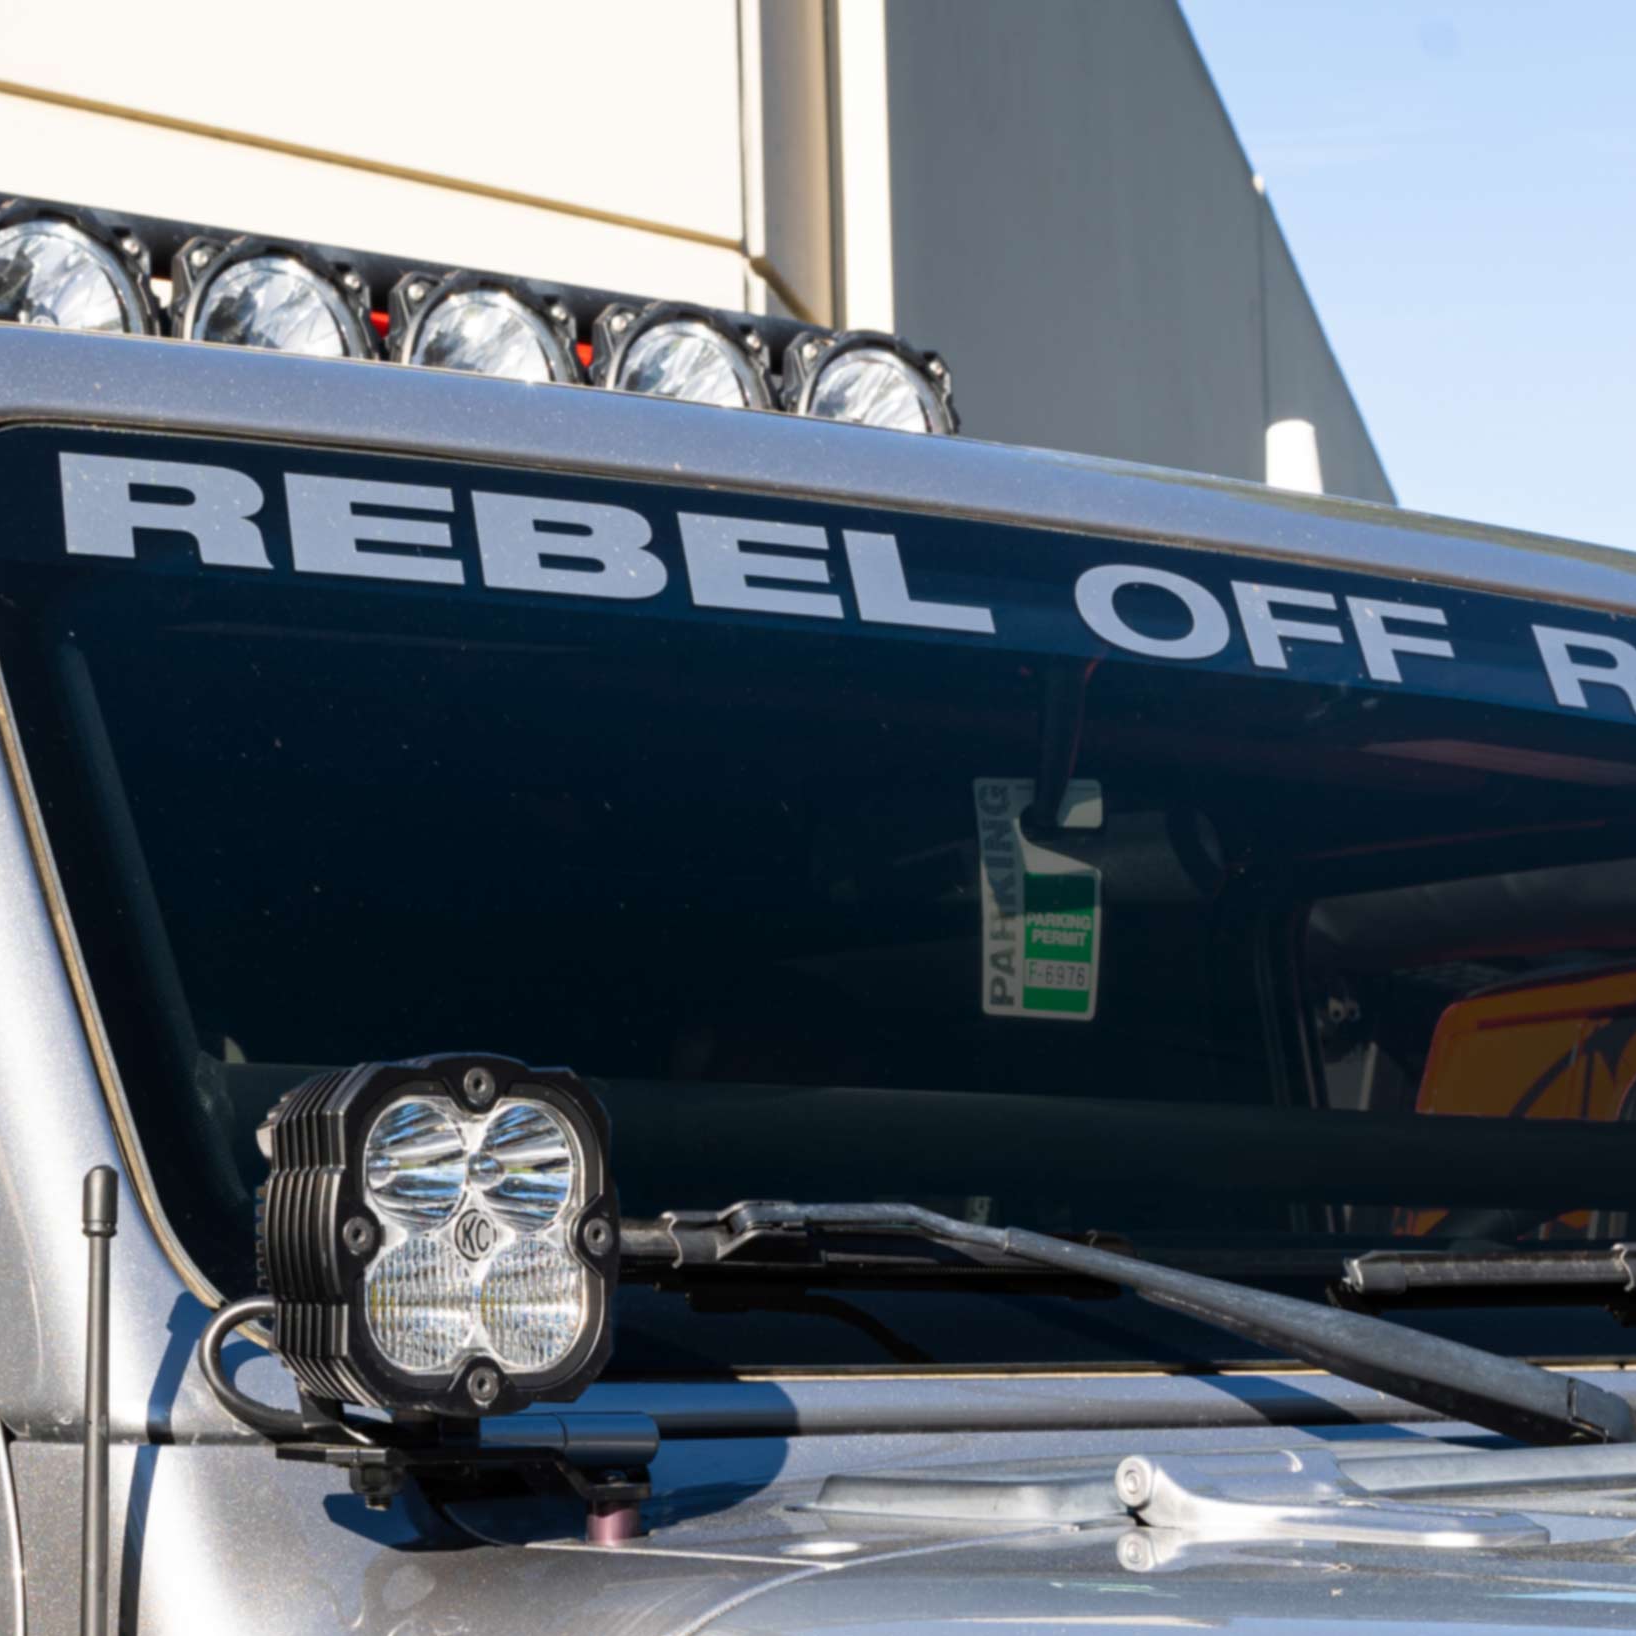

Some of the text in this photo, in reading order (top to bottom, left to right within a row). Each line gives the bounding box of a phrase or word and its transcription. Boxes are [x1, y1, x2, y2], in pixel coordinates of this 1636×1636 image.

[57, 451, 996, 634] REBEL
[1074, 563, 1454, 684] OFF
[1026, 911, 1092, 931] PARKING
[1031, 928, 1087, 947] PERMIT
[460, 1213, 493, 1257] KC
